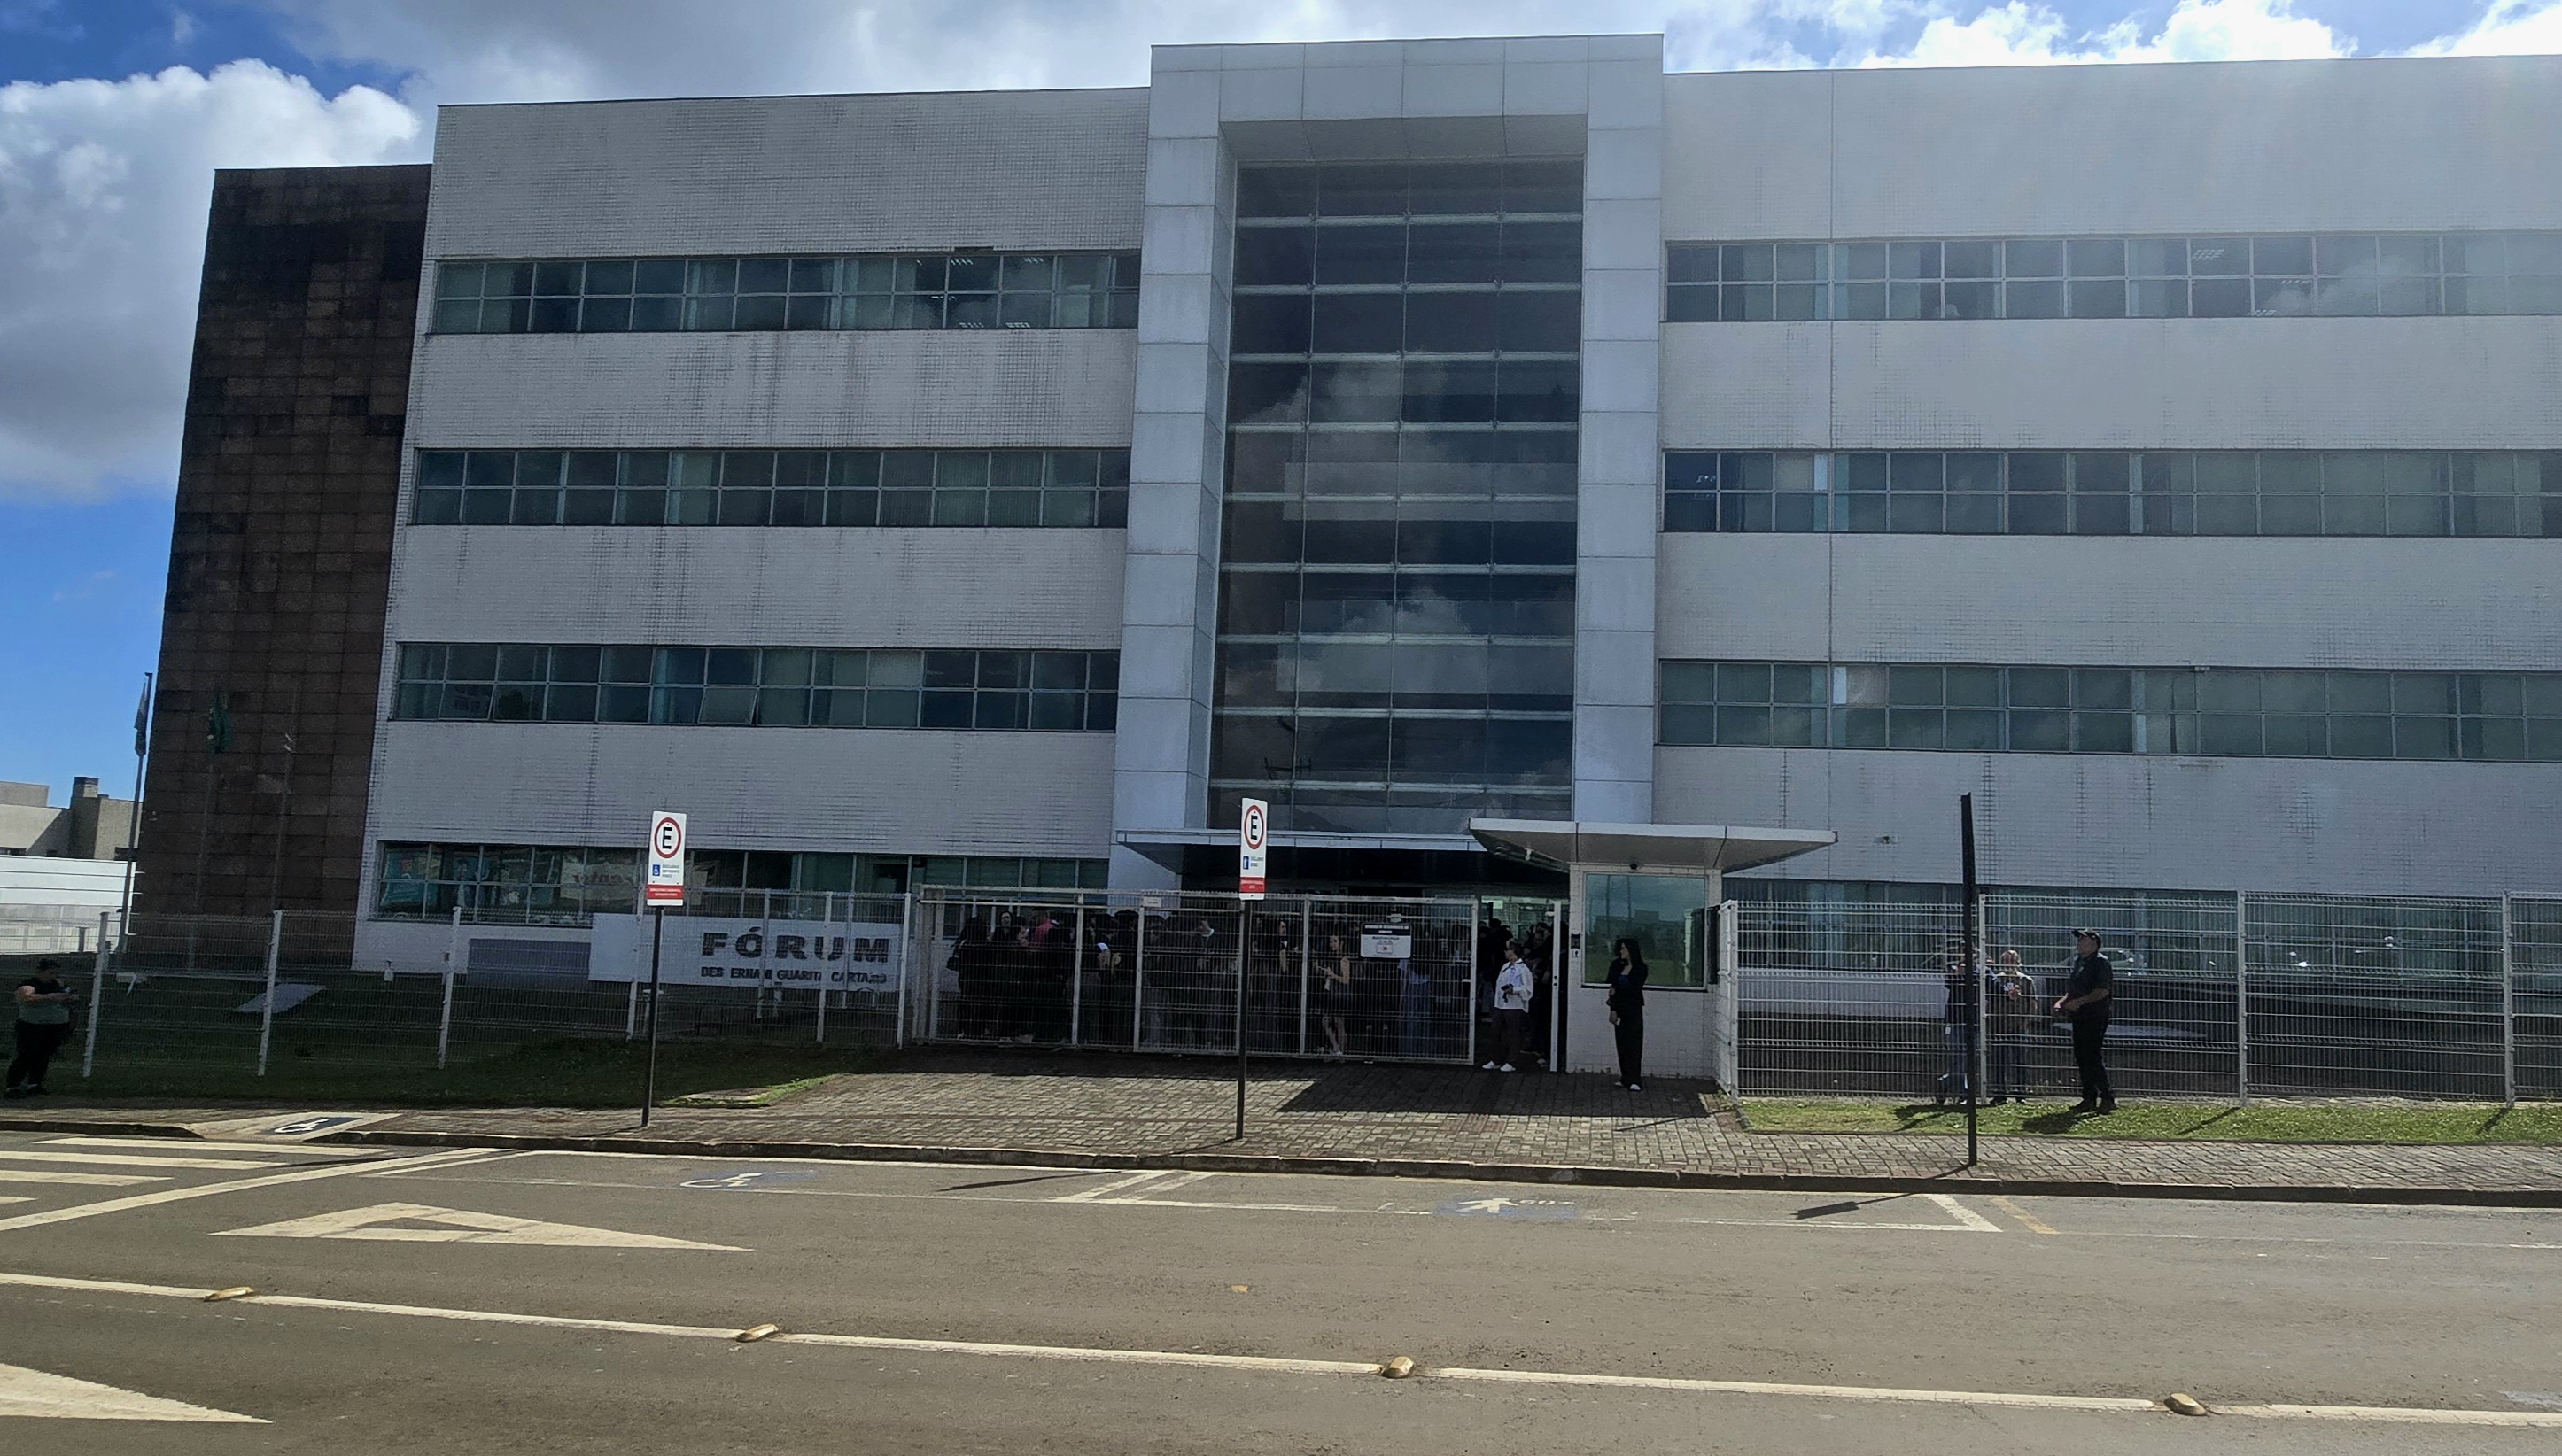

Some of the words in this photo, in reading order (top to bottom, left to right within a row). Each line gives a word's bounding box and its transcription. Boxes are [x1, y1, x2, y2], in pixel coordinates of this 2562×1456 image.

[662, 826, 672, 849] E
[1250, 815, 1258, 840] E
[701, 926, 890, 964] FÓRUM
[700, 966, 725, 978] DES
